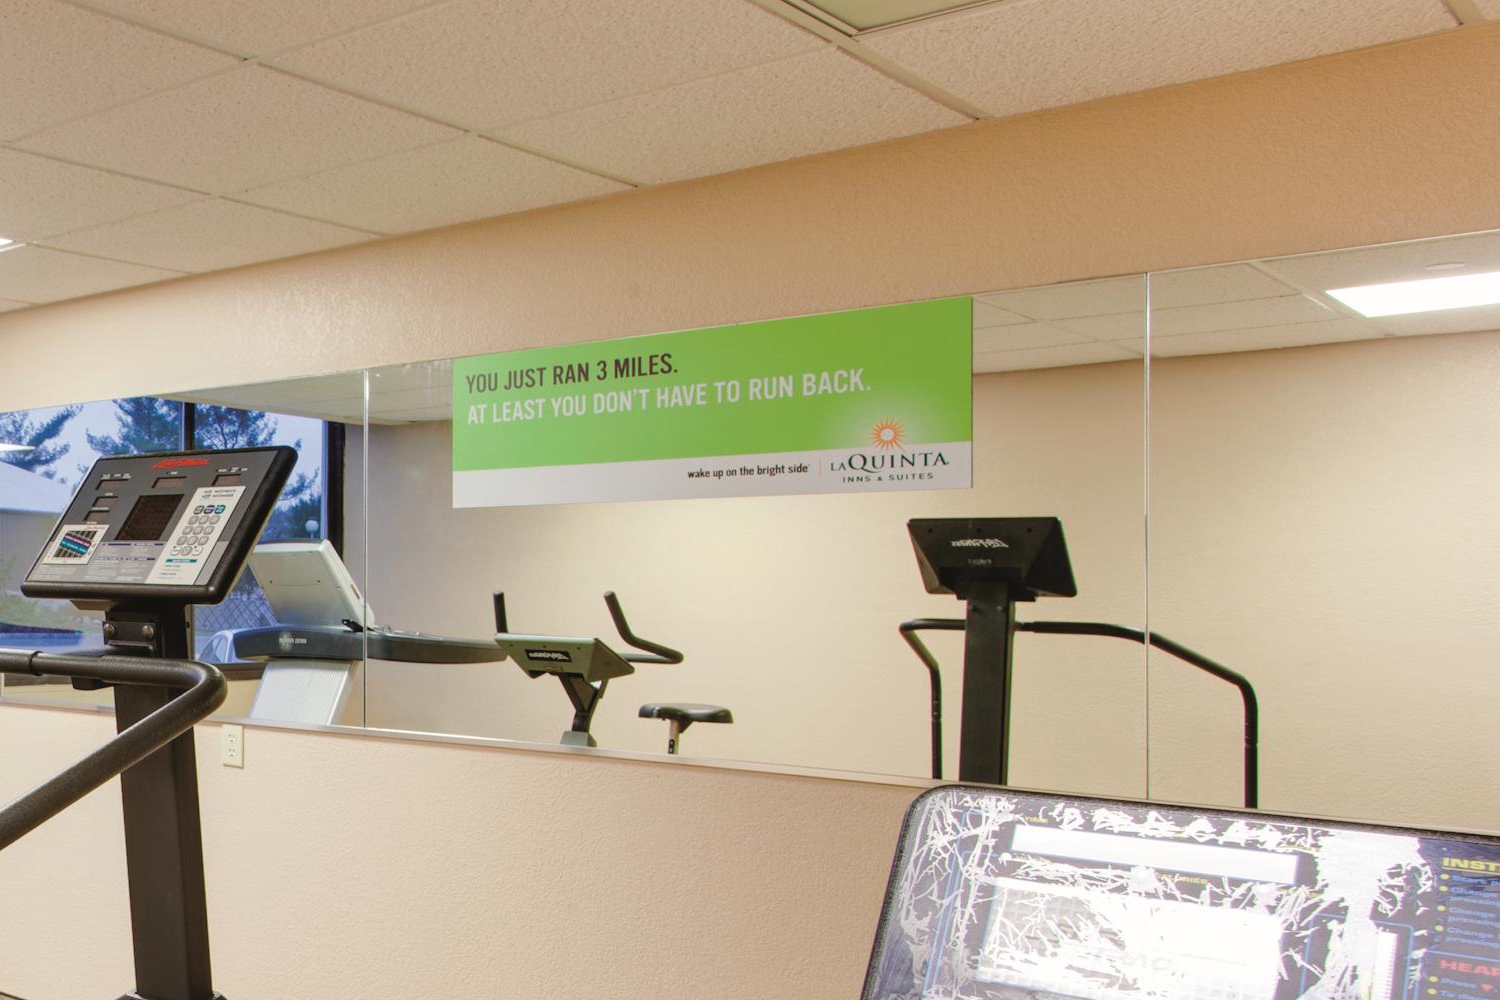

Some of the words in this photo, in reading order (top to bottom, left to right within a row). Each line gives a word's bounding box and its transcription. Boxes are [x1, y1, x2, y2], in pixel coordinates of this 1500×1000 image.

[465, 373, 499, 394] YOU
[504, 367, 547, 390] JUST
[553, 362, 590, 385] RAN
[596, 360, 608, 381] 3
[613, 353, 679, 379] MILES.
[467, 404, 488, 425] AT
[492, 398, 547, 423] LEAST
[551, 394, 587, 417] YOU
[593, 388, 650, 414] DON'T
[656, 383, 708, 409] HAVE
[713, 380, 741, 404] TO
[749, 375, 794, 401] RUN
[802, 368, 872, 397] BACK.
[687, 468, 710, 478] wake
[712, 469, 724, 480] up
[726, 469, 737, 477] on
[740, 466, 755, 476] the
[756, 464, 785, 477] bright
[842, 475, 871, 483] INNS
[889, 472, 934, 481] SUITES
